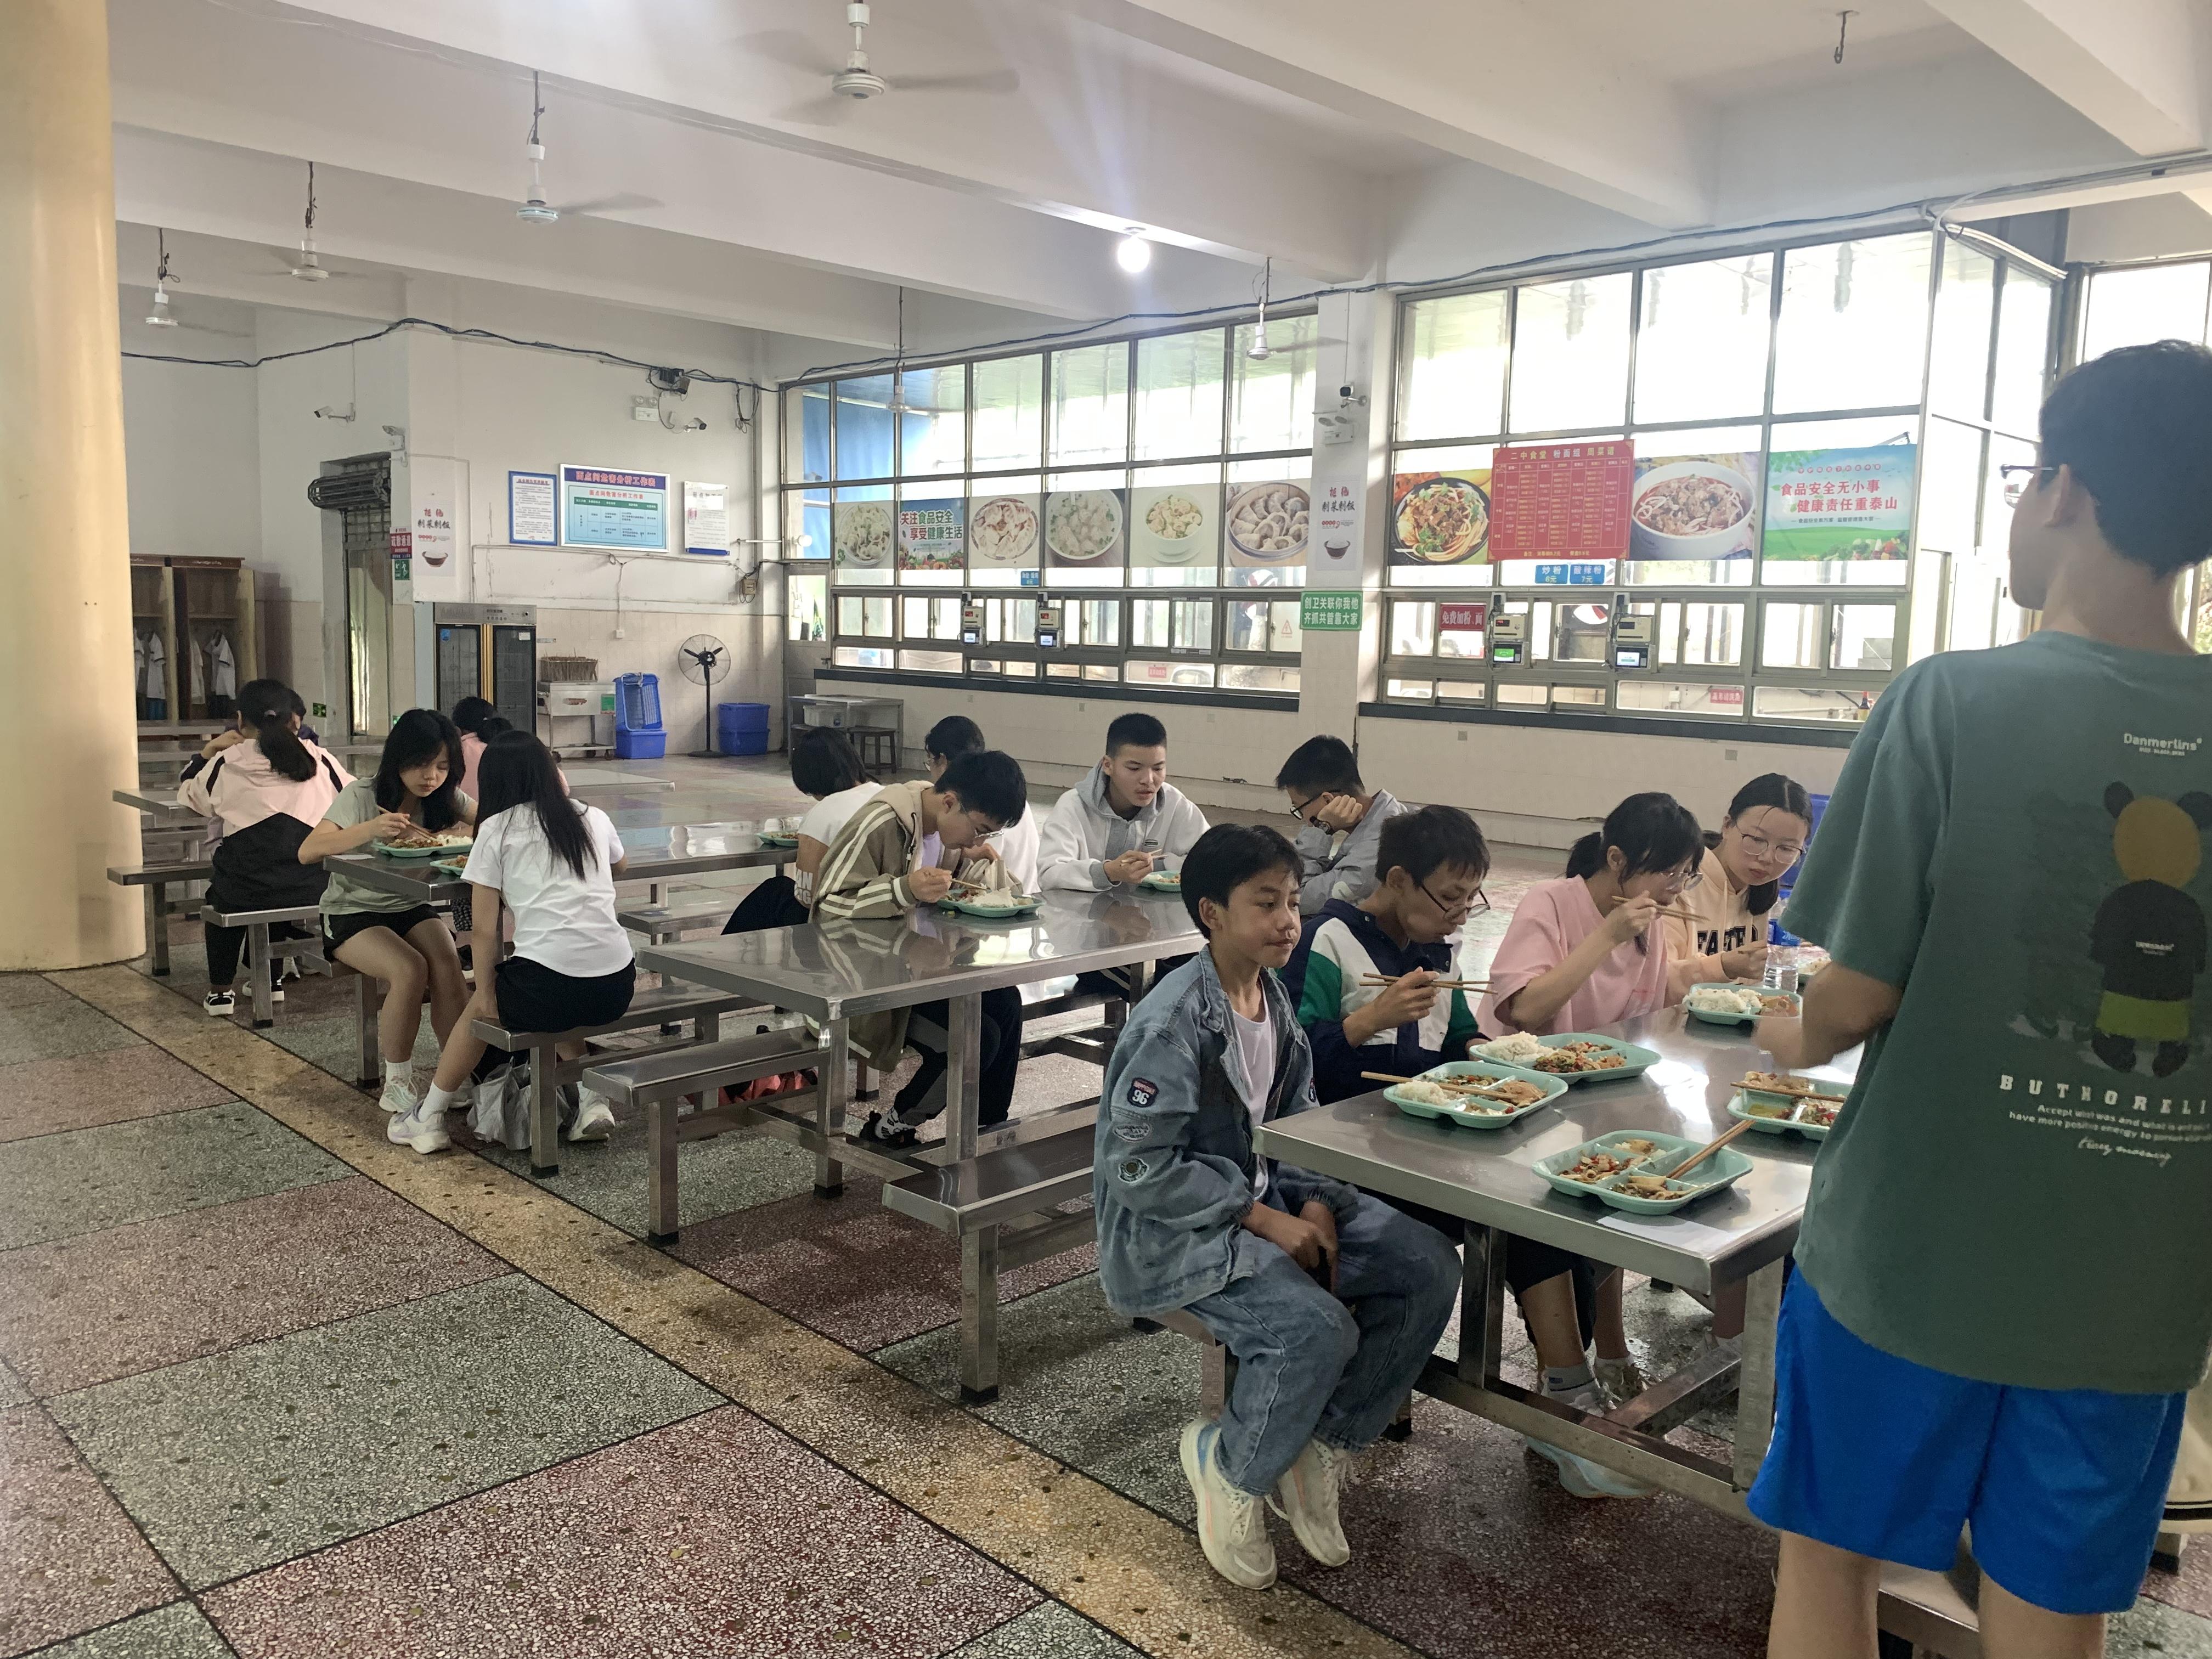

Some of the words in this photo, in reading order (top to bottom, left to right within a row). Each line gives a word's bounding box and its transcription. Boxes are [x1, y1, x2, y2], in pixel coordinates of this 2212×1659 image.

[1781, 479, 1880, 496] 食品安全无小事
[1797, 496, 1898, 513] 健康责任重泰山
[900, 510, 953, 526] 关注食品安全
[910, 526, 963, 540] 享受健康生活
[1545, 575, 1557, 583] 6元
[1305, 596, 1359, 610] 创卫关联你我他
[1304, 612, 1358, 625] 齐抓共管靠大家
[1442, 610, 1483, 625] 免费加粉、面
[1132, 1089, 1150, 1105] 96
[2009, 1110, 2036, 1123] have
